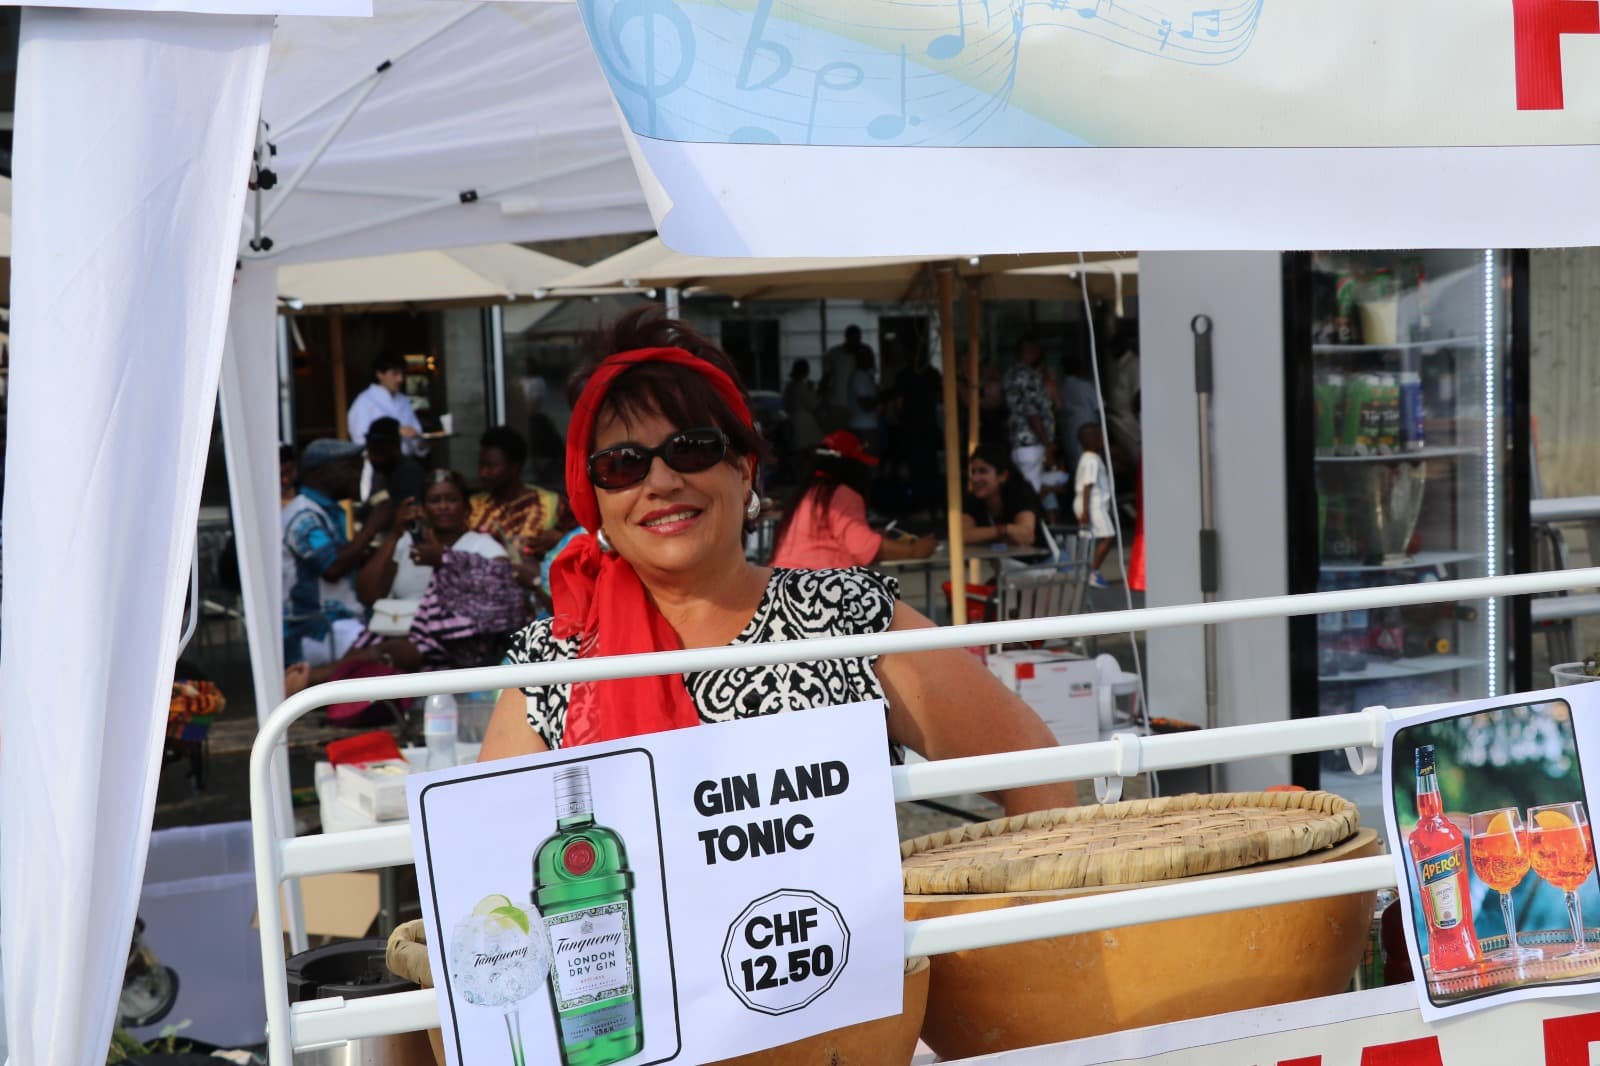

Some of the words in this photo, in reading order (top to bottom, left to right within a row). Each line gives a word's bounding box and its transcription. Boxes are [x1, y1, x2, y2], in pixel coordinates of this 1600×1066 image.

[693, 774, 760, 816] GIN
[770, 761, 849, 806] AND
[698, 814, 815, 865] TONIC
[1423, 855, 1461, 881] APEROL
[745, 908, 818, 949] CHF
[556, 931, 622, 955] Tanqueray
[472, 946, 528, 968] Tanqueray
[568, 950, 615, 968] LONDON
[570, 965, 591, 977] DRY
[596, 960, 616, 972] GIN
[740, 944, 834, 993] 12.50
